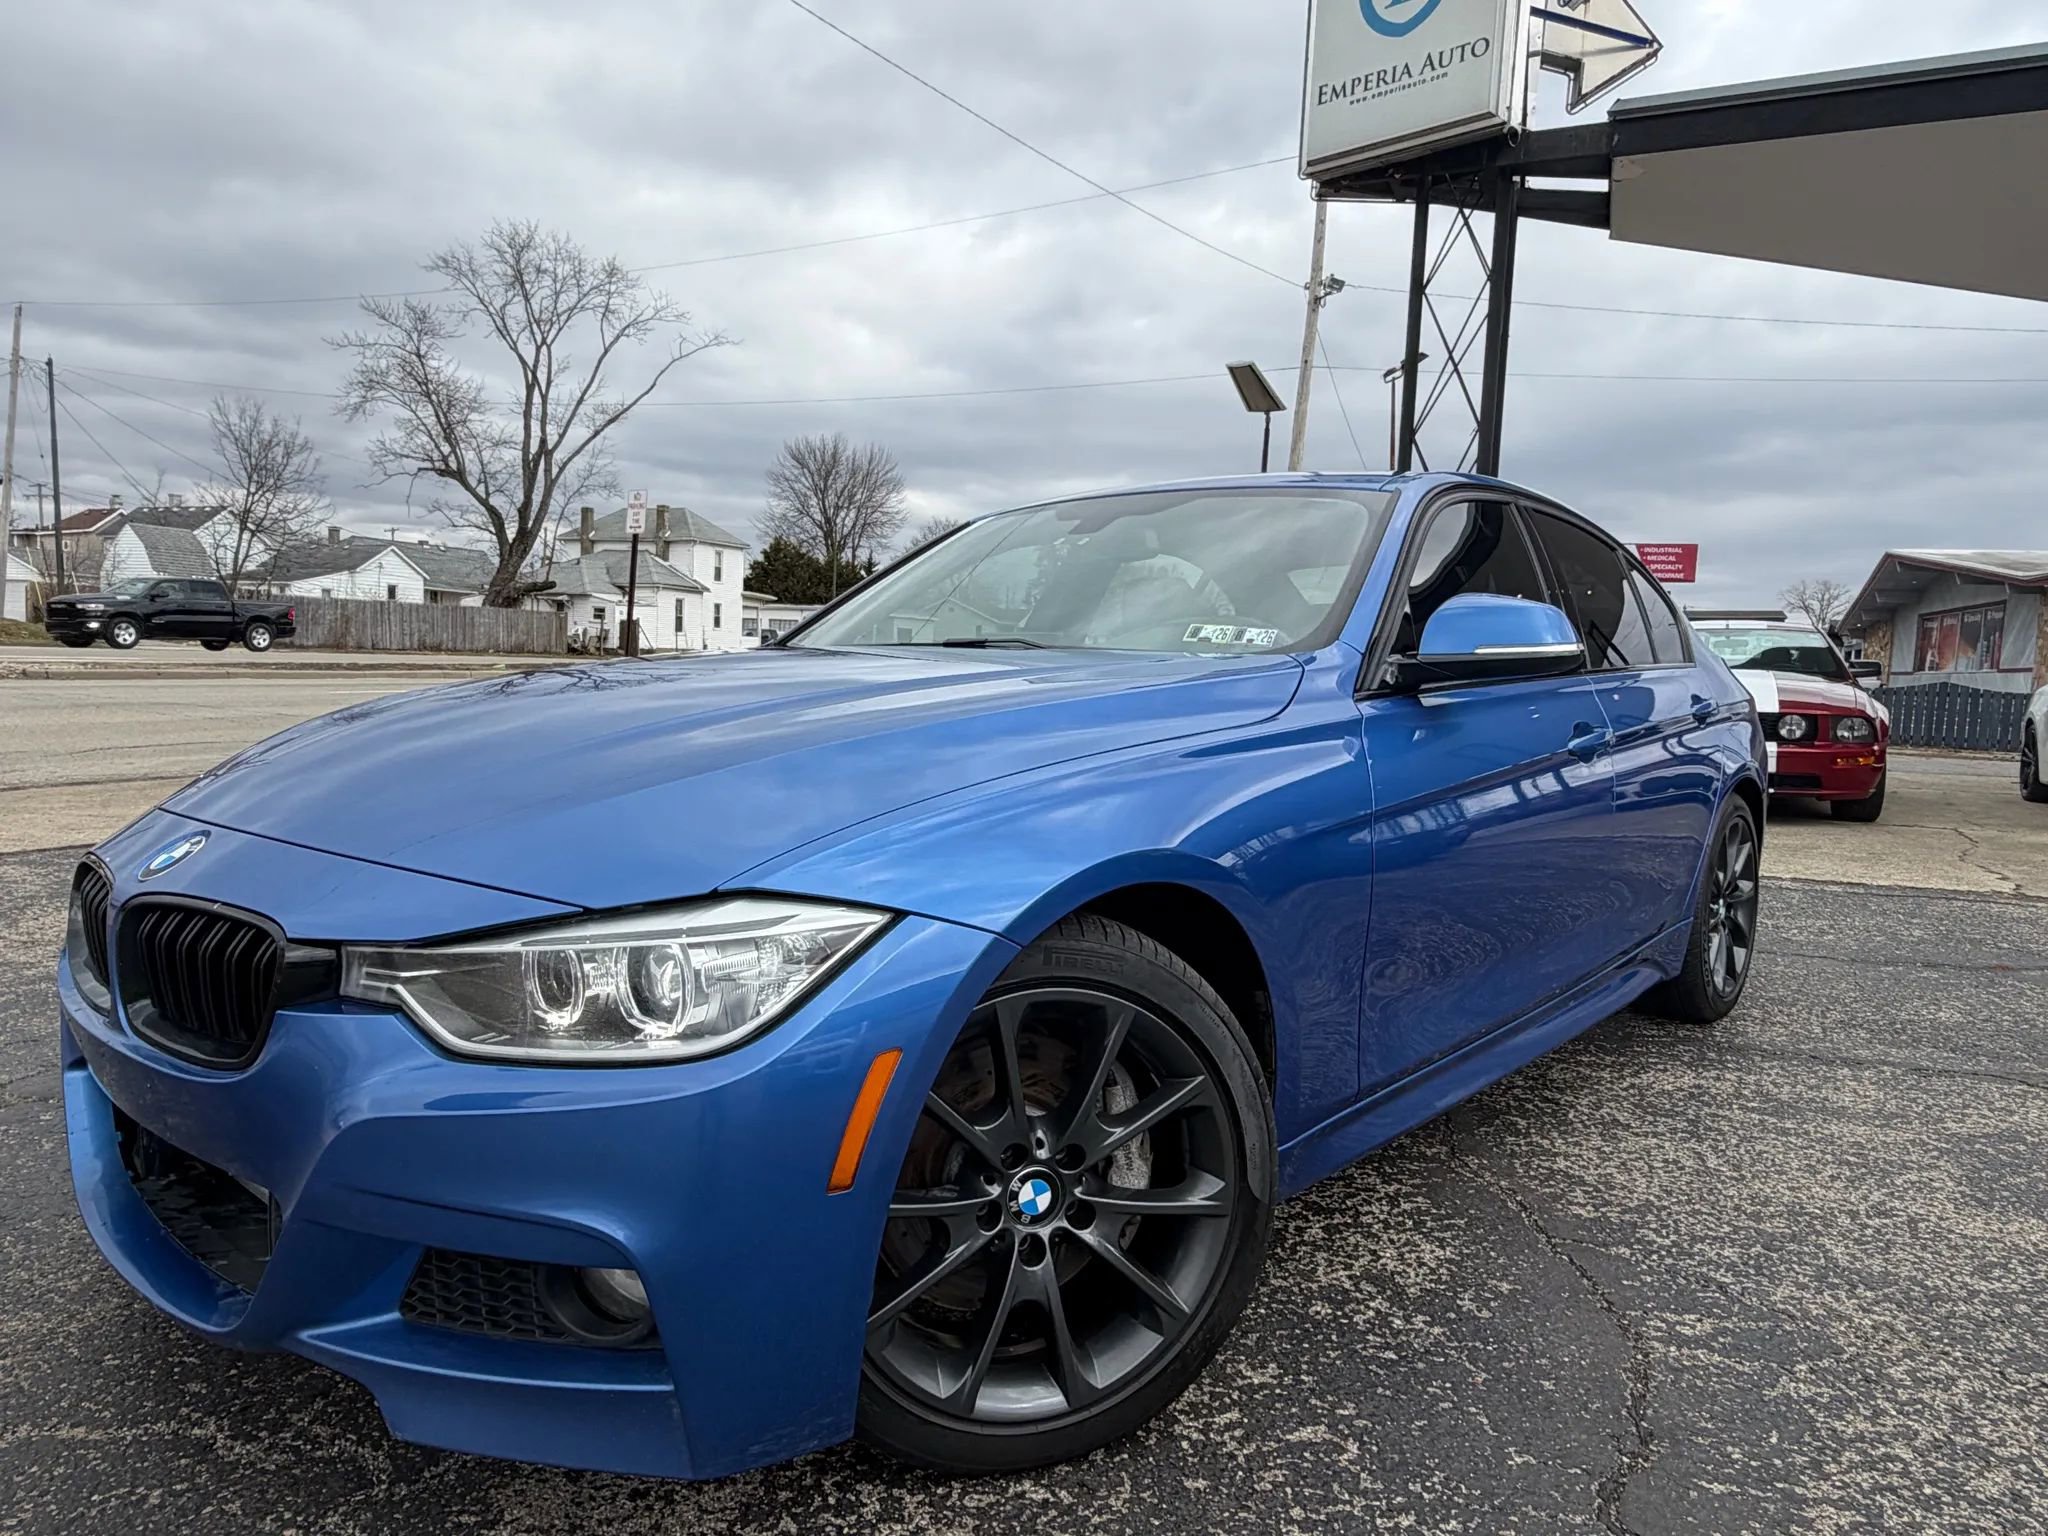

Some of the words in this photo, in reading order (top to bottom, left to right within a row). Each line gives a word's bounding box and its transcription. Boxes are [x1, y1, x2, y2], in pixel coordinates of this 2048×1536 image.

[1317, 62, 1413, 106] EMPERIA
[1419, 36, 1491, 76] AUTO
[1349, 71, 1449, 106] www.emperiaauto.com
[1215, 627, 1231, 641] 26
[1260, 630, 1275, 644] 26
[1043, 944, 1126, 976] PIRELLI
[1123, 1143, 1135, 1172] BMW
[1009, 1179, 1032, 1224] BMW
